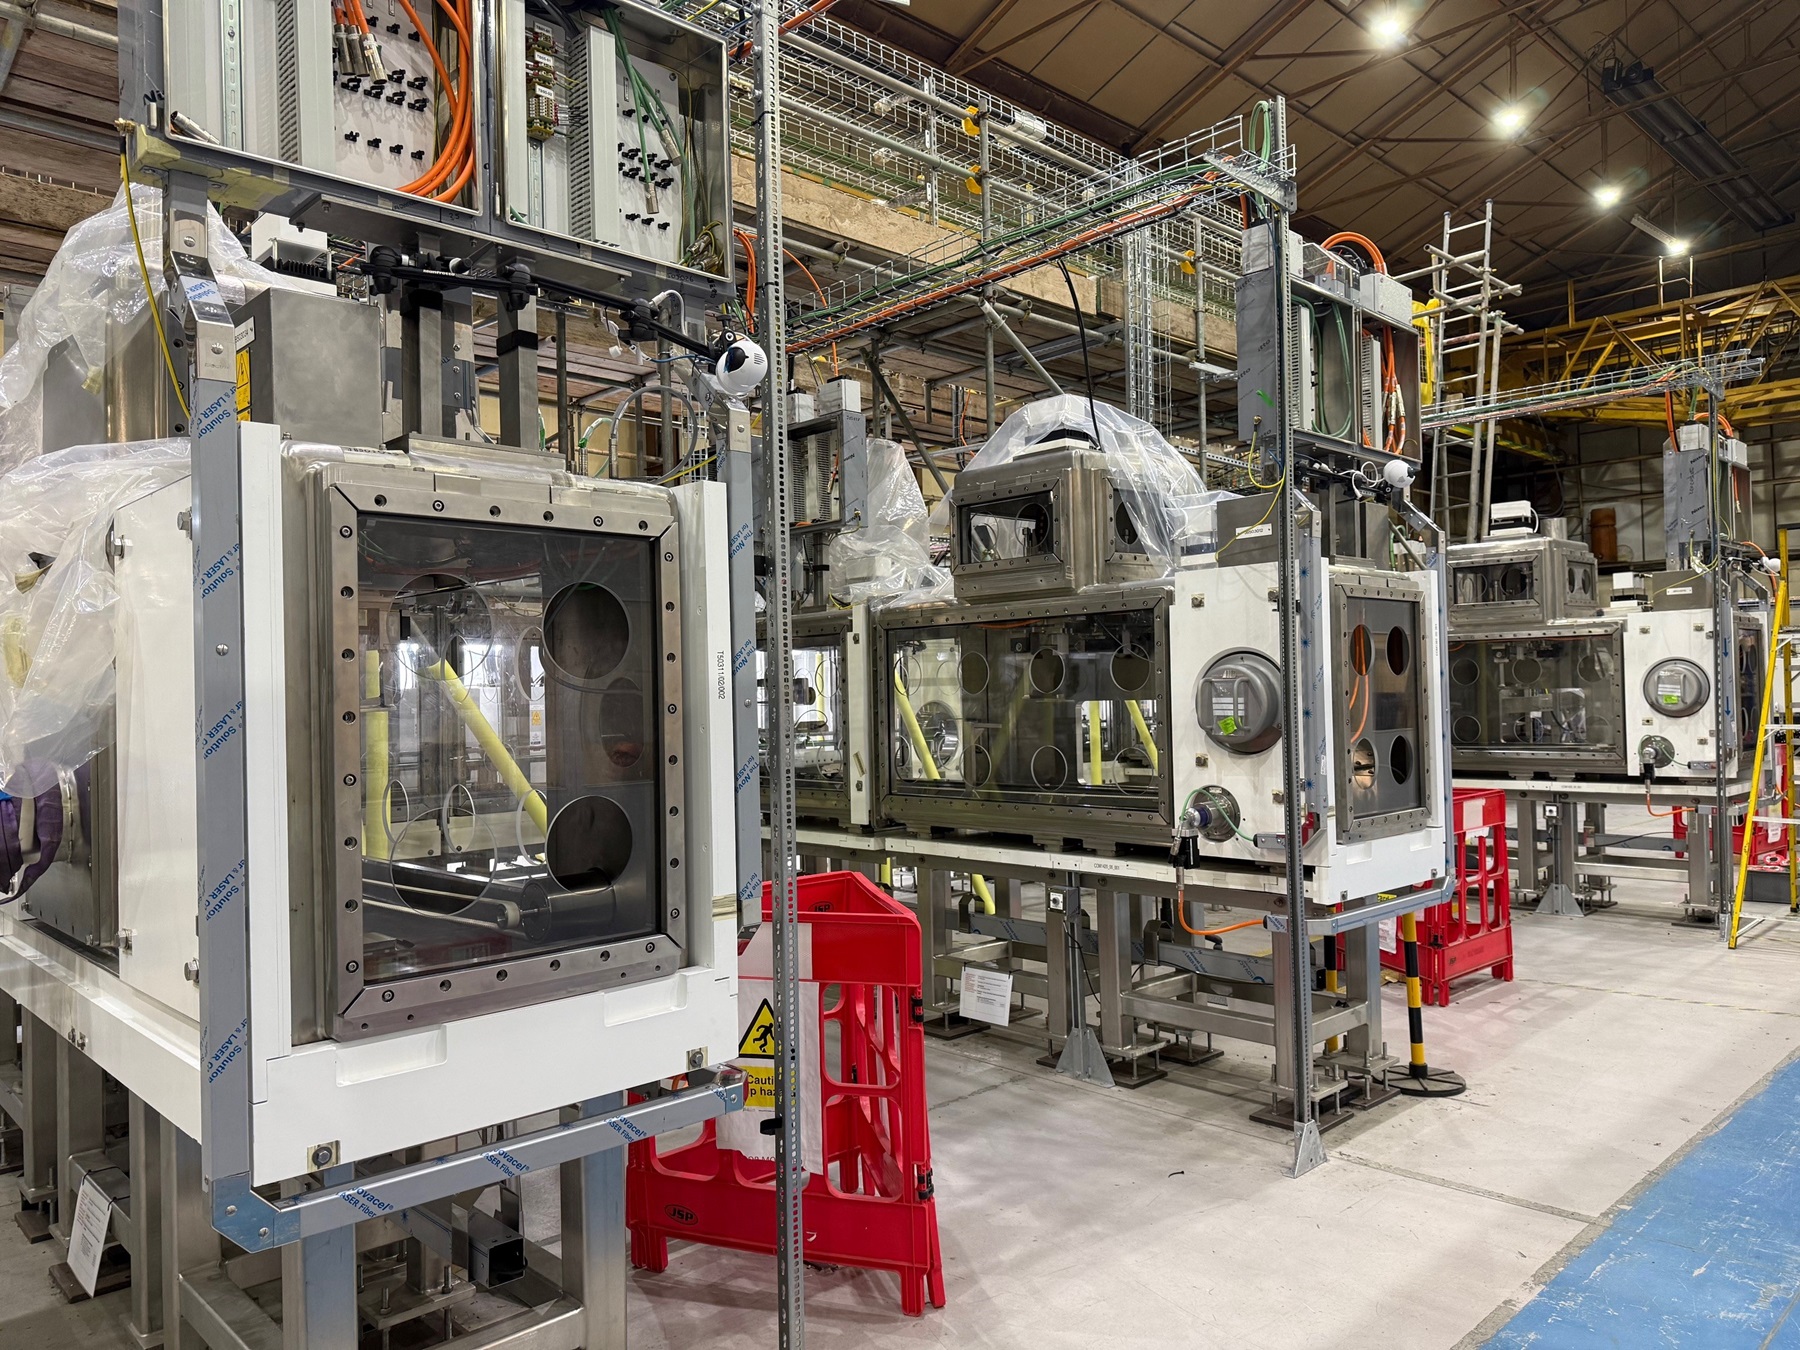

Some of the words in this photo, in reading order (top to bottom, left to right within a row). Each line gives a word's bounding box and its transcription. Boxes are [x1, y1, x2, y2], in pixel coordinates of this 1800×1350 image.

[200, 396, 226, 419] LASER
[202, 555, 229, 579] LASER
[205, 714, 232, 739] LASER
[209, 873, 235, 900] LASER
[212, 1033, 238, 1061] LASER
[748, 1074, 774, 1085] Cauti
[760, 1087, 775, 1096] haz
[499, 1164, 516, 1178] Fiber
[358, 1203, 377, 1218] Fiber
[671, 1207, 694, 1221] JSP
